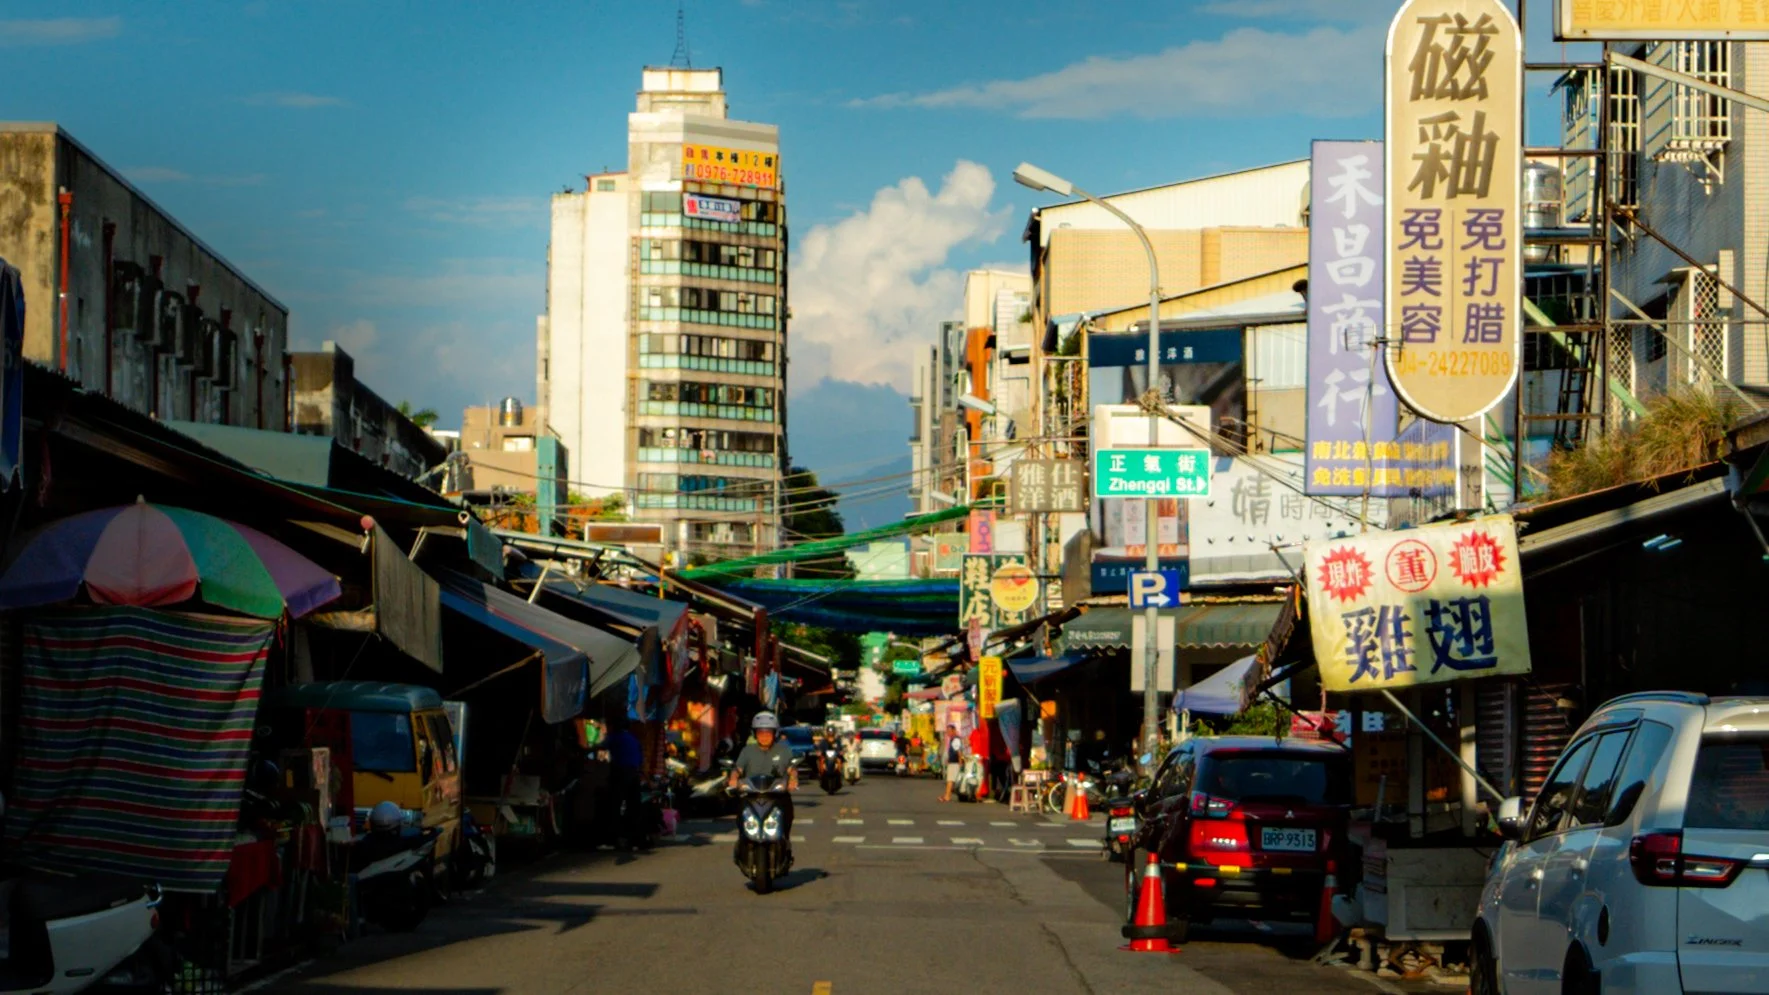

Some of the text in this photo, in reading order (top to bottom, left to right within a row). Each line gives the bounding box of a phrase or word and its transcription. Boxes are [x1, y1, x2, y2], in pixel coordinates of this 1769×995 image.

[1408, 12, 1500, 200] 磁釉
[1398, 208, 1443, 344] 免美容
[1109, 454, 1196, 473] 正氣街
[1109, 477, 1170, 494] Zhengqi
[1327, 559, 1364, 587] 現炸
[1460, 545, 1496, 573] 脆皮
[1132, 573, 1167, 606] P
[1341, 594, 1499, 683] 雞翅
